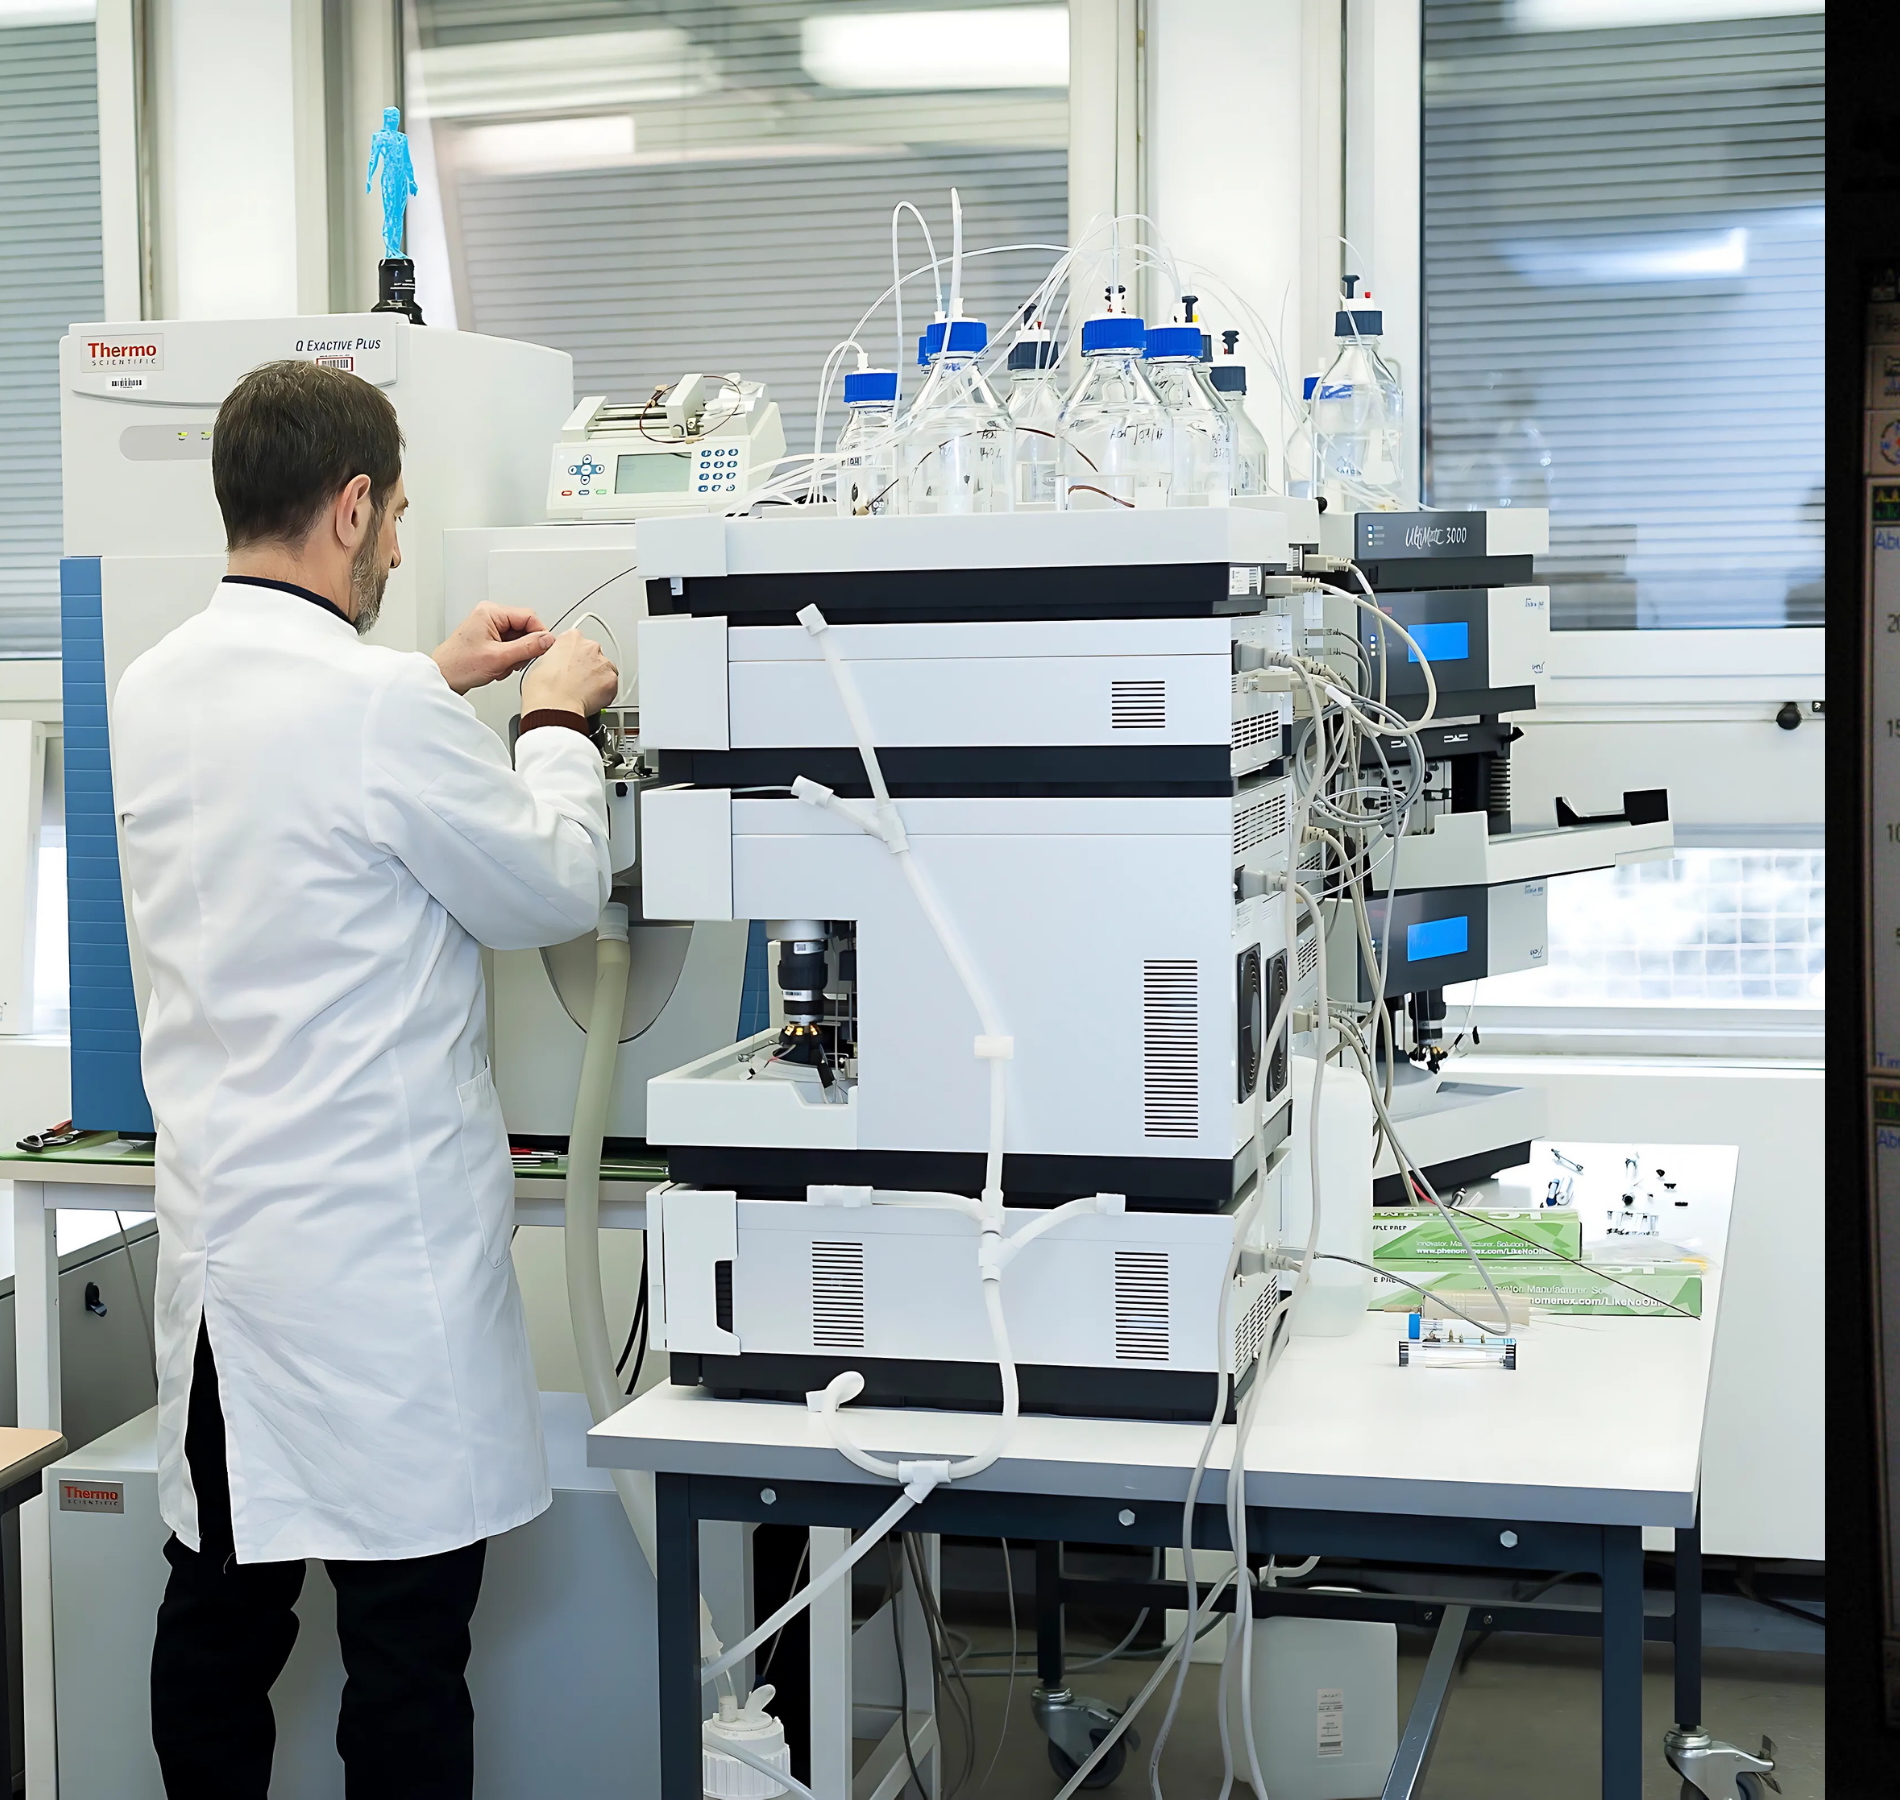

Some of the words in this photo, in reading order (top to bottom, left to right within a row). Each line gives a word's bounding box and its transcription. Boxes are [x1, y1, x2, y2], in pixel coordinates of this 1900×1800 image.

[1875, 313, 1899, 333] File
[88, 343, 157, 359] Thermo
[295, 340, 304, 352] Q
[307, 339, 353, 352] EXACTIVE
[356, 337, 382, 350] PLUS
[91, 358, 156, 367] SCIENTIFIC
[1446, 526, 1467, 545] 3000
[64, 1486, 118, 1500] Thermo
